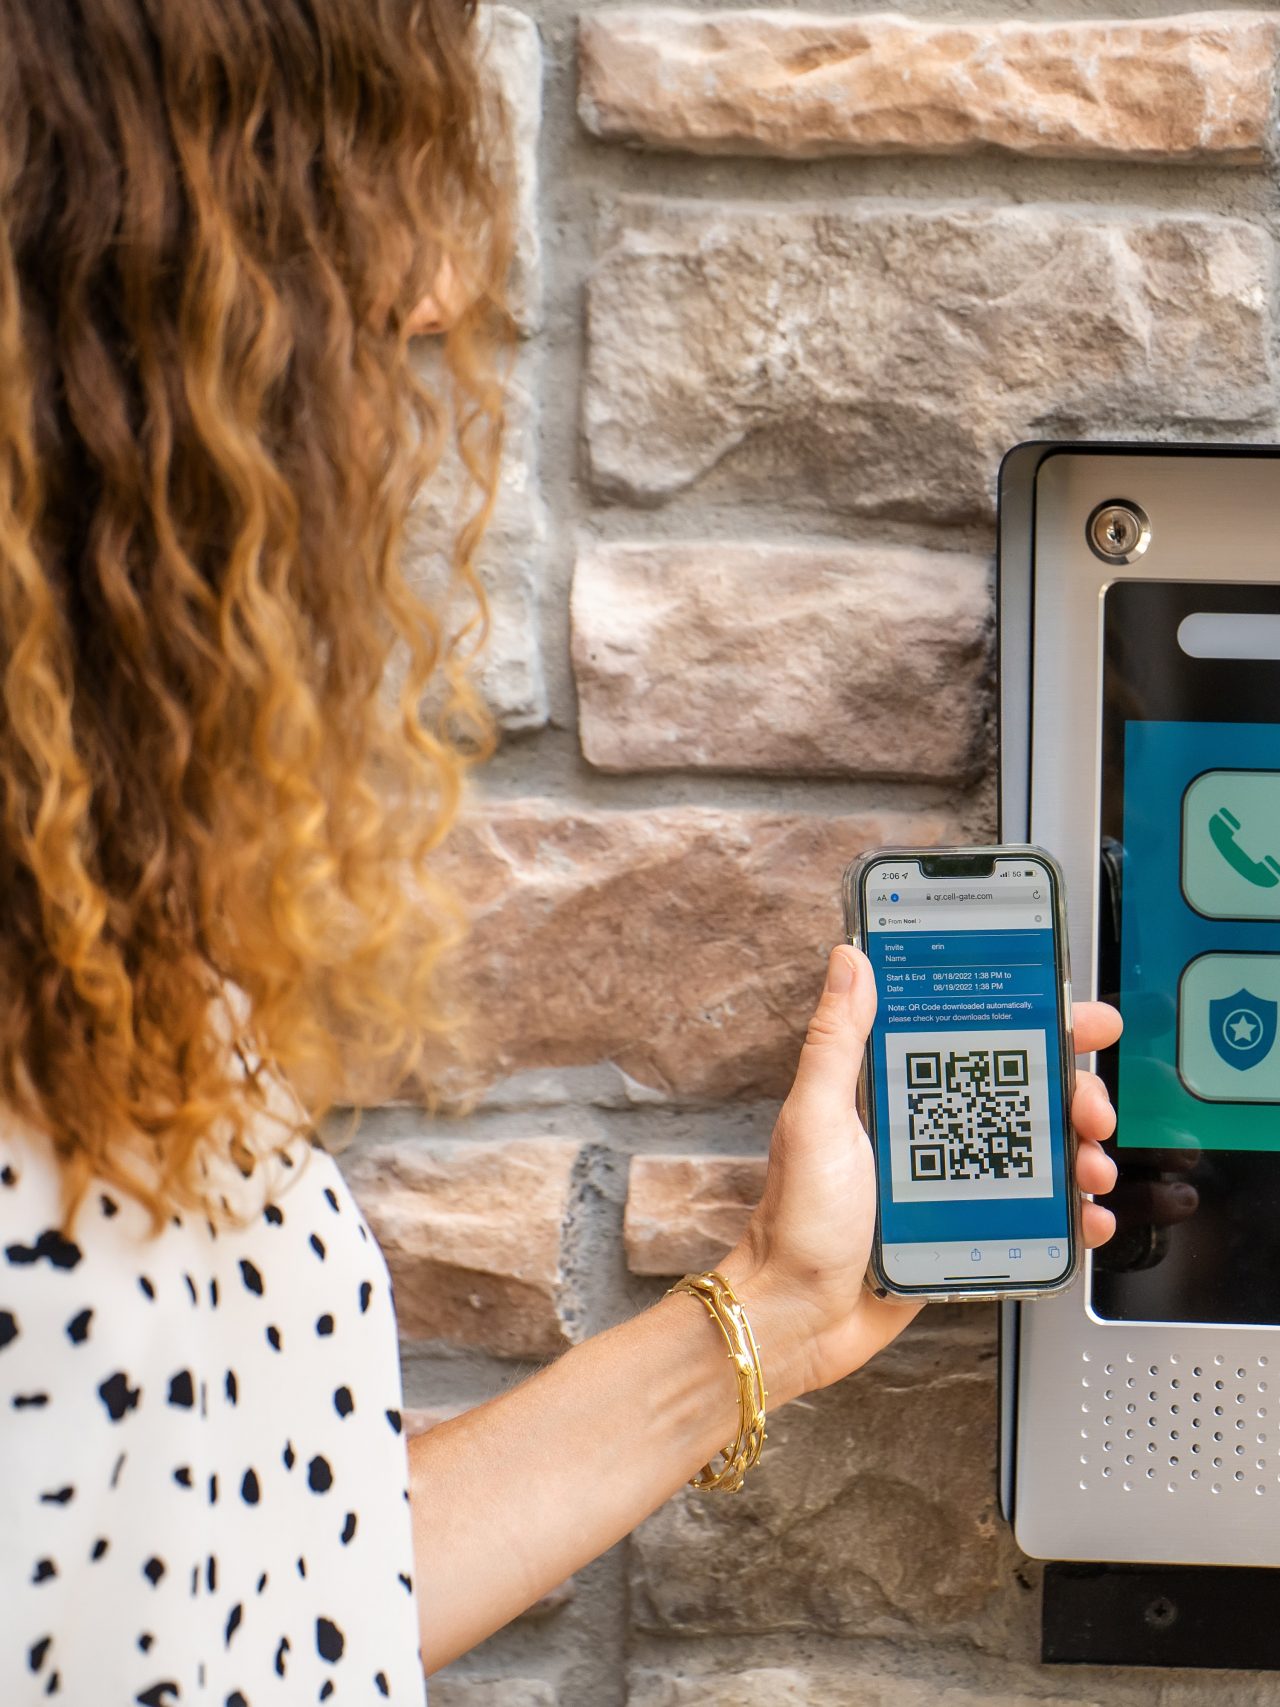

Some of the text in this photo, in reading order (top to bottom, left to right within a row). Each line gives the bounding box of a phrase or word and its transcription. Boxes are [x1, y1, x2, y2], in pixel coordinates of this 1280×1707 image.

[882, 872, 899, 880] 2:06
[933, 893, 993, 901] qr.cell-gate.com
[888, 1004, 907, 1012] Note:
[922, 1003, 940, 1011] Code
[942, 1002, 985, 1010] downloaded
[913, 1014, 933, 1022] check
[935, 1014, 950, 1023] your
